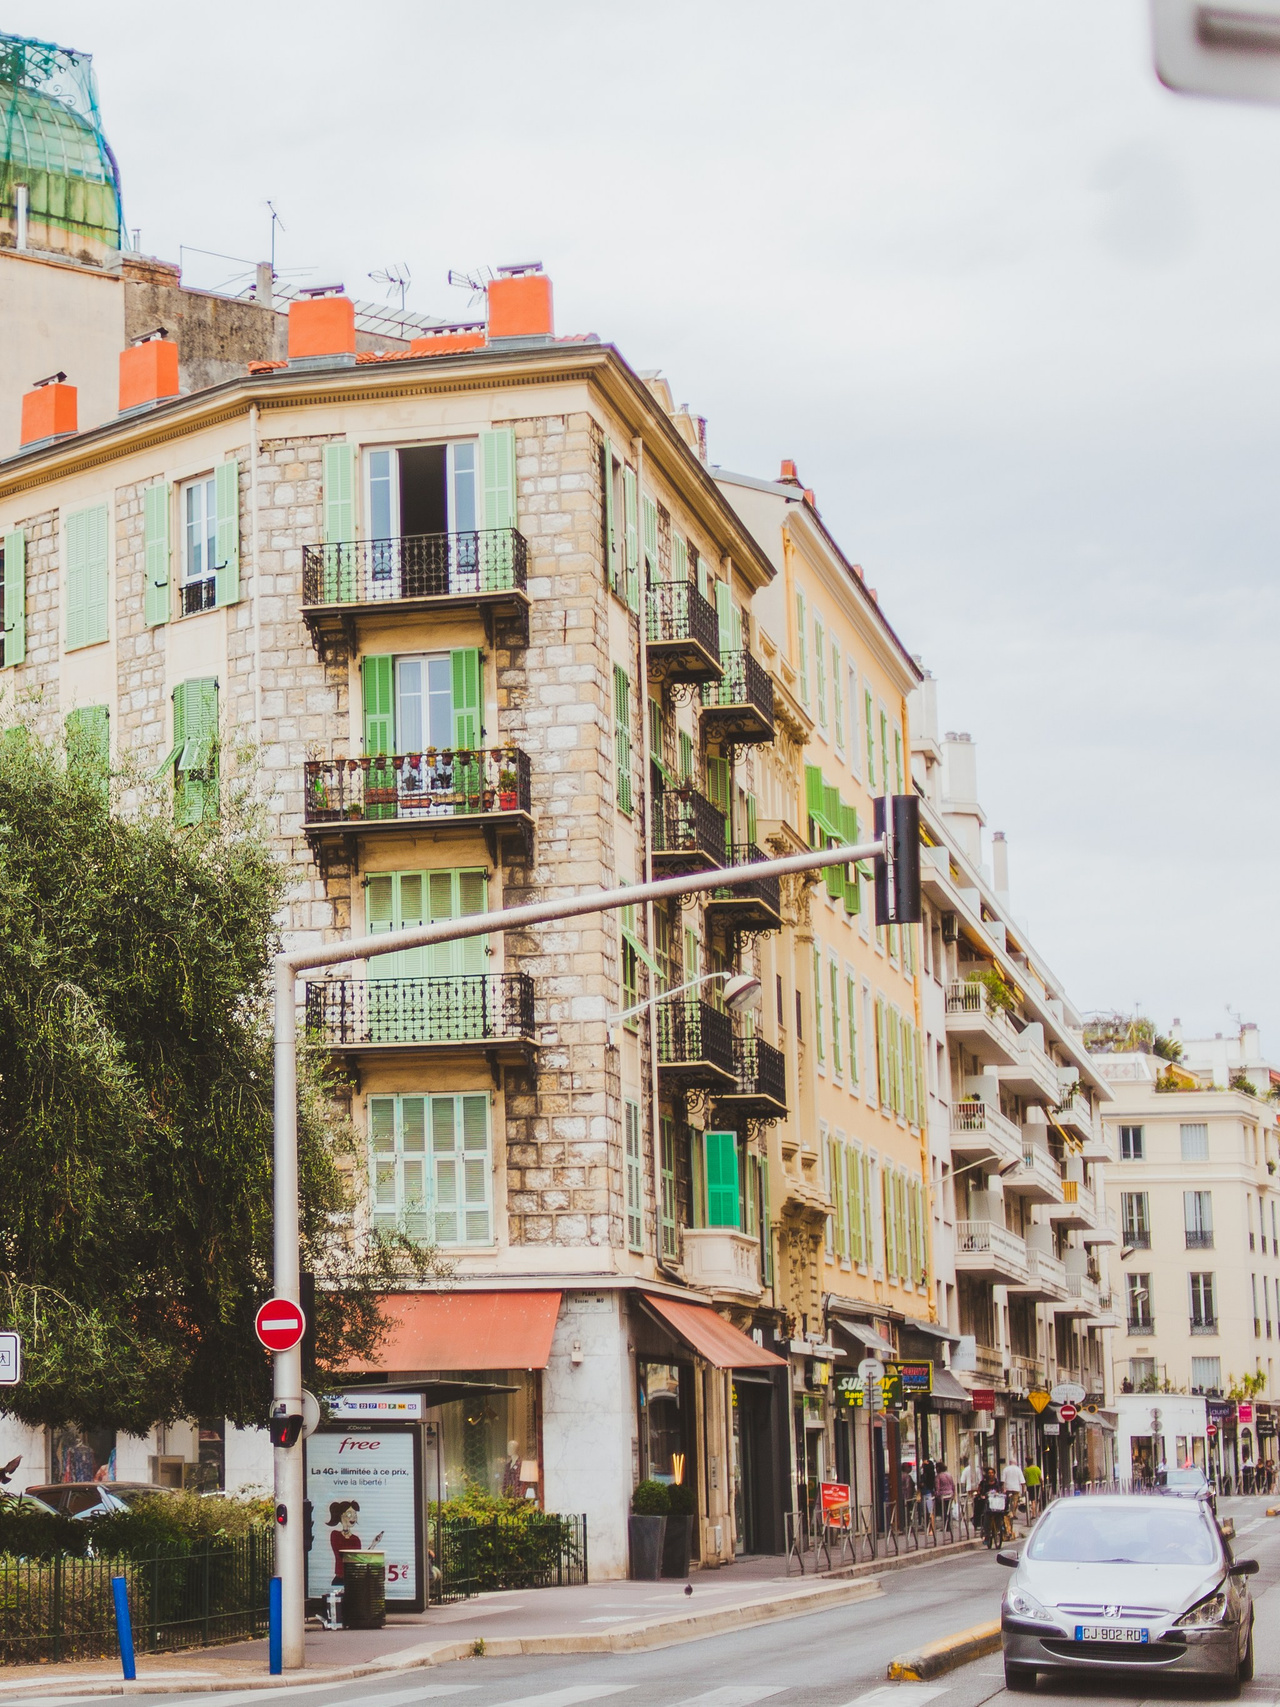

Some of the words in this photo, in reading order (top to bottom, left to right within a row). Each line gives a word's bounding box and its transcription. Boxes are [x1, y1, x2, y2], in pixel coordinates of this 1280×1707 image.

[338, 1437, 381, 1454] free
[373, 1467, 378, 1475] à
[391, 1468, 409, 1477] prix,
[359, 1478, 382, 1486] liberté
[387, 1564, 399, 1582] 5
